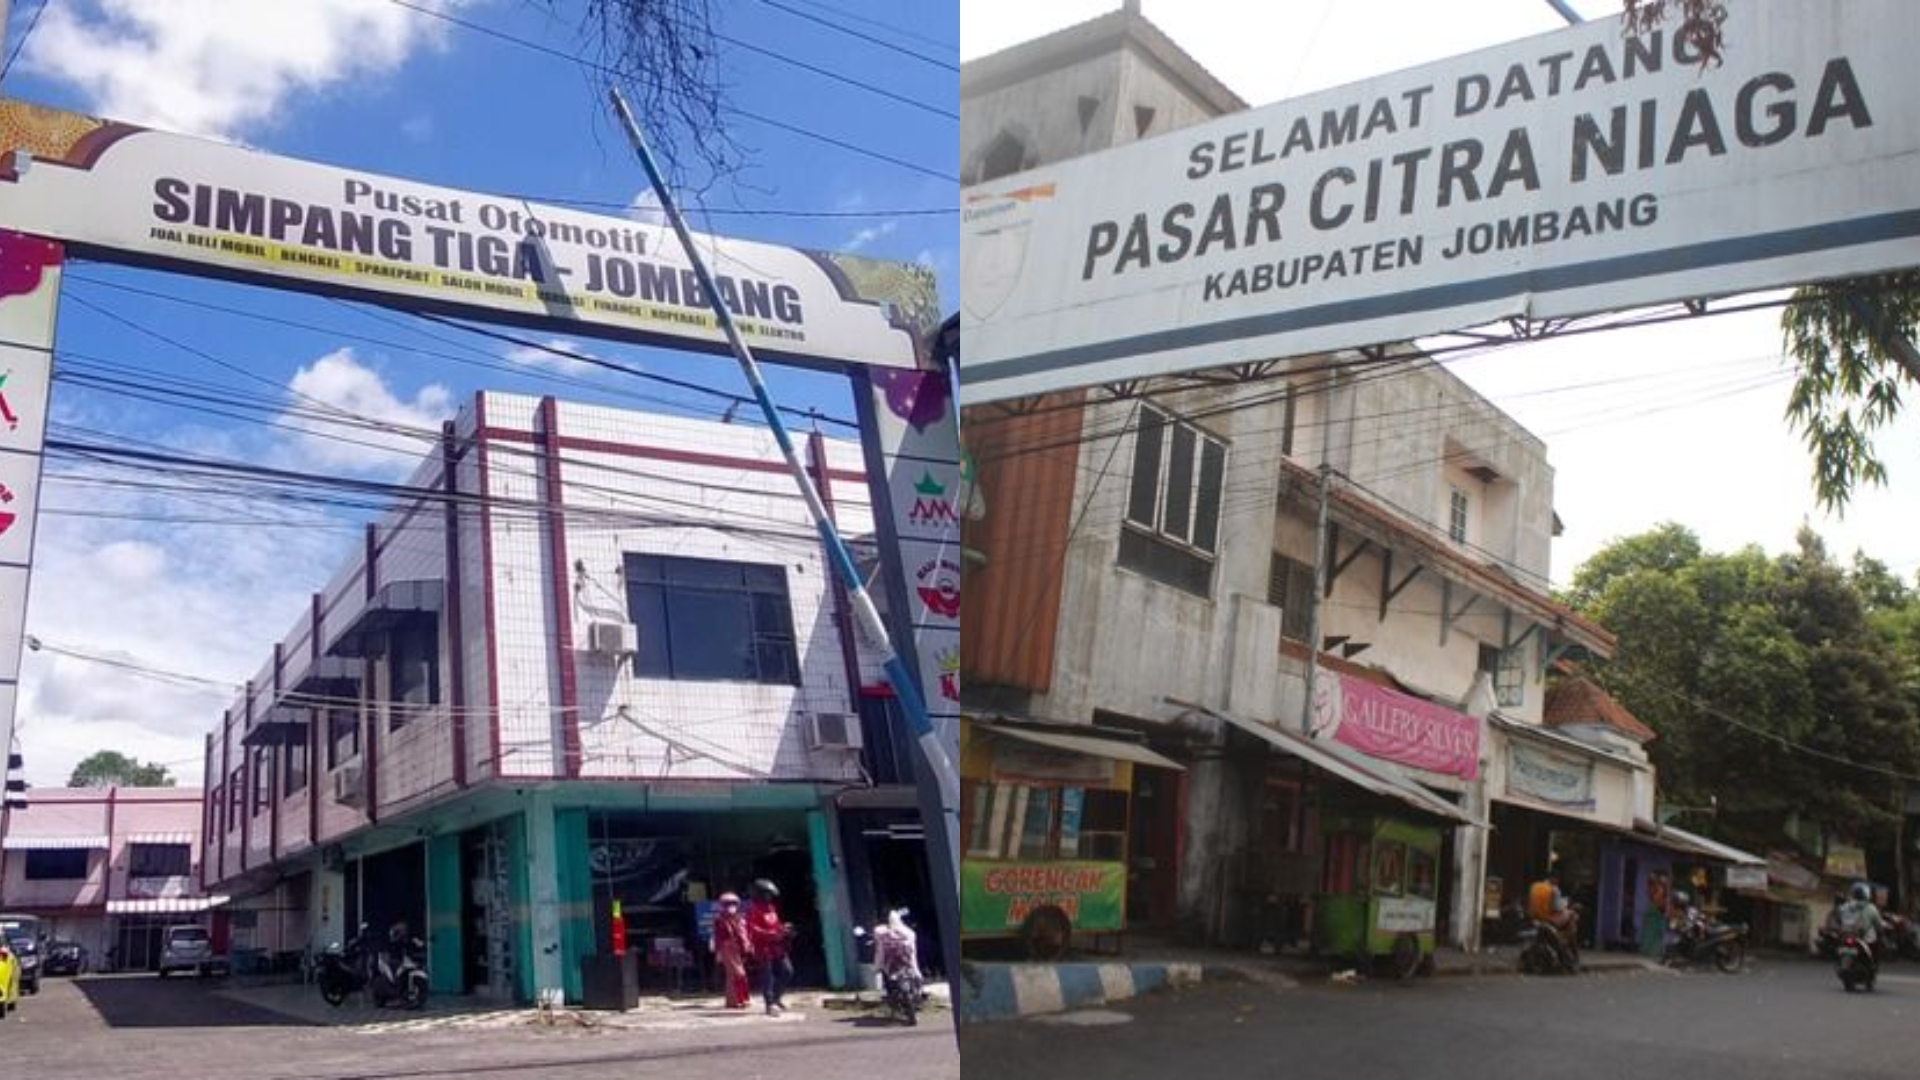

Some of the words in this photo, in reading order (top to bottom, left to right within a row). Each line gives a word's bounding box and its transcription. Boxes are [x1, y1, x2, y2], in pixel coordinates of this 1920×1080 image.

[1081, 181, 1286, 282] PASAR
[1308, 126, 1540, 231] CITRA
[1570, 56, 1873, 183] NIAGA
[1187, 85, 1434, 181] SELAMAT
[150, 226, 183, 243] JUAL
[187, 233, 218, 249] BELI
[221, 238, 266, 257] MOBIL
[280, 248, 341, 269] BENGKEL
[355, 261, 430, 284] SPAREPART
[441, 275, 482, 292] SALON
[485, 282, 524, 299] MOBIL
[153, 177, 413, 264] SIMPANG
[425, 225, 546, 284] TIGA
[584, 253, 803, 325] JOMBANG
[344, 178, 463, 225] Pusat
[478, 203, 649, 256] Otomotif
[1202, 236, 1424, 302] KABUPATEN
[1442, 193, 1659, 259] JOMBANG
[984, 868, 1102, 894] GORENGAN
